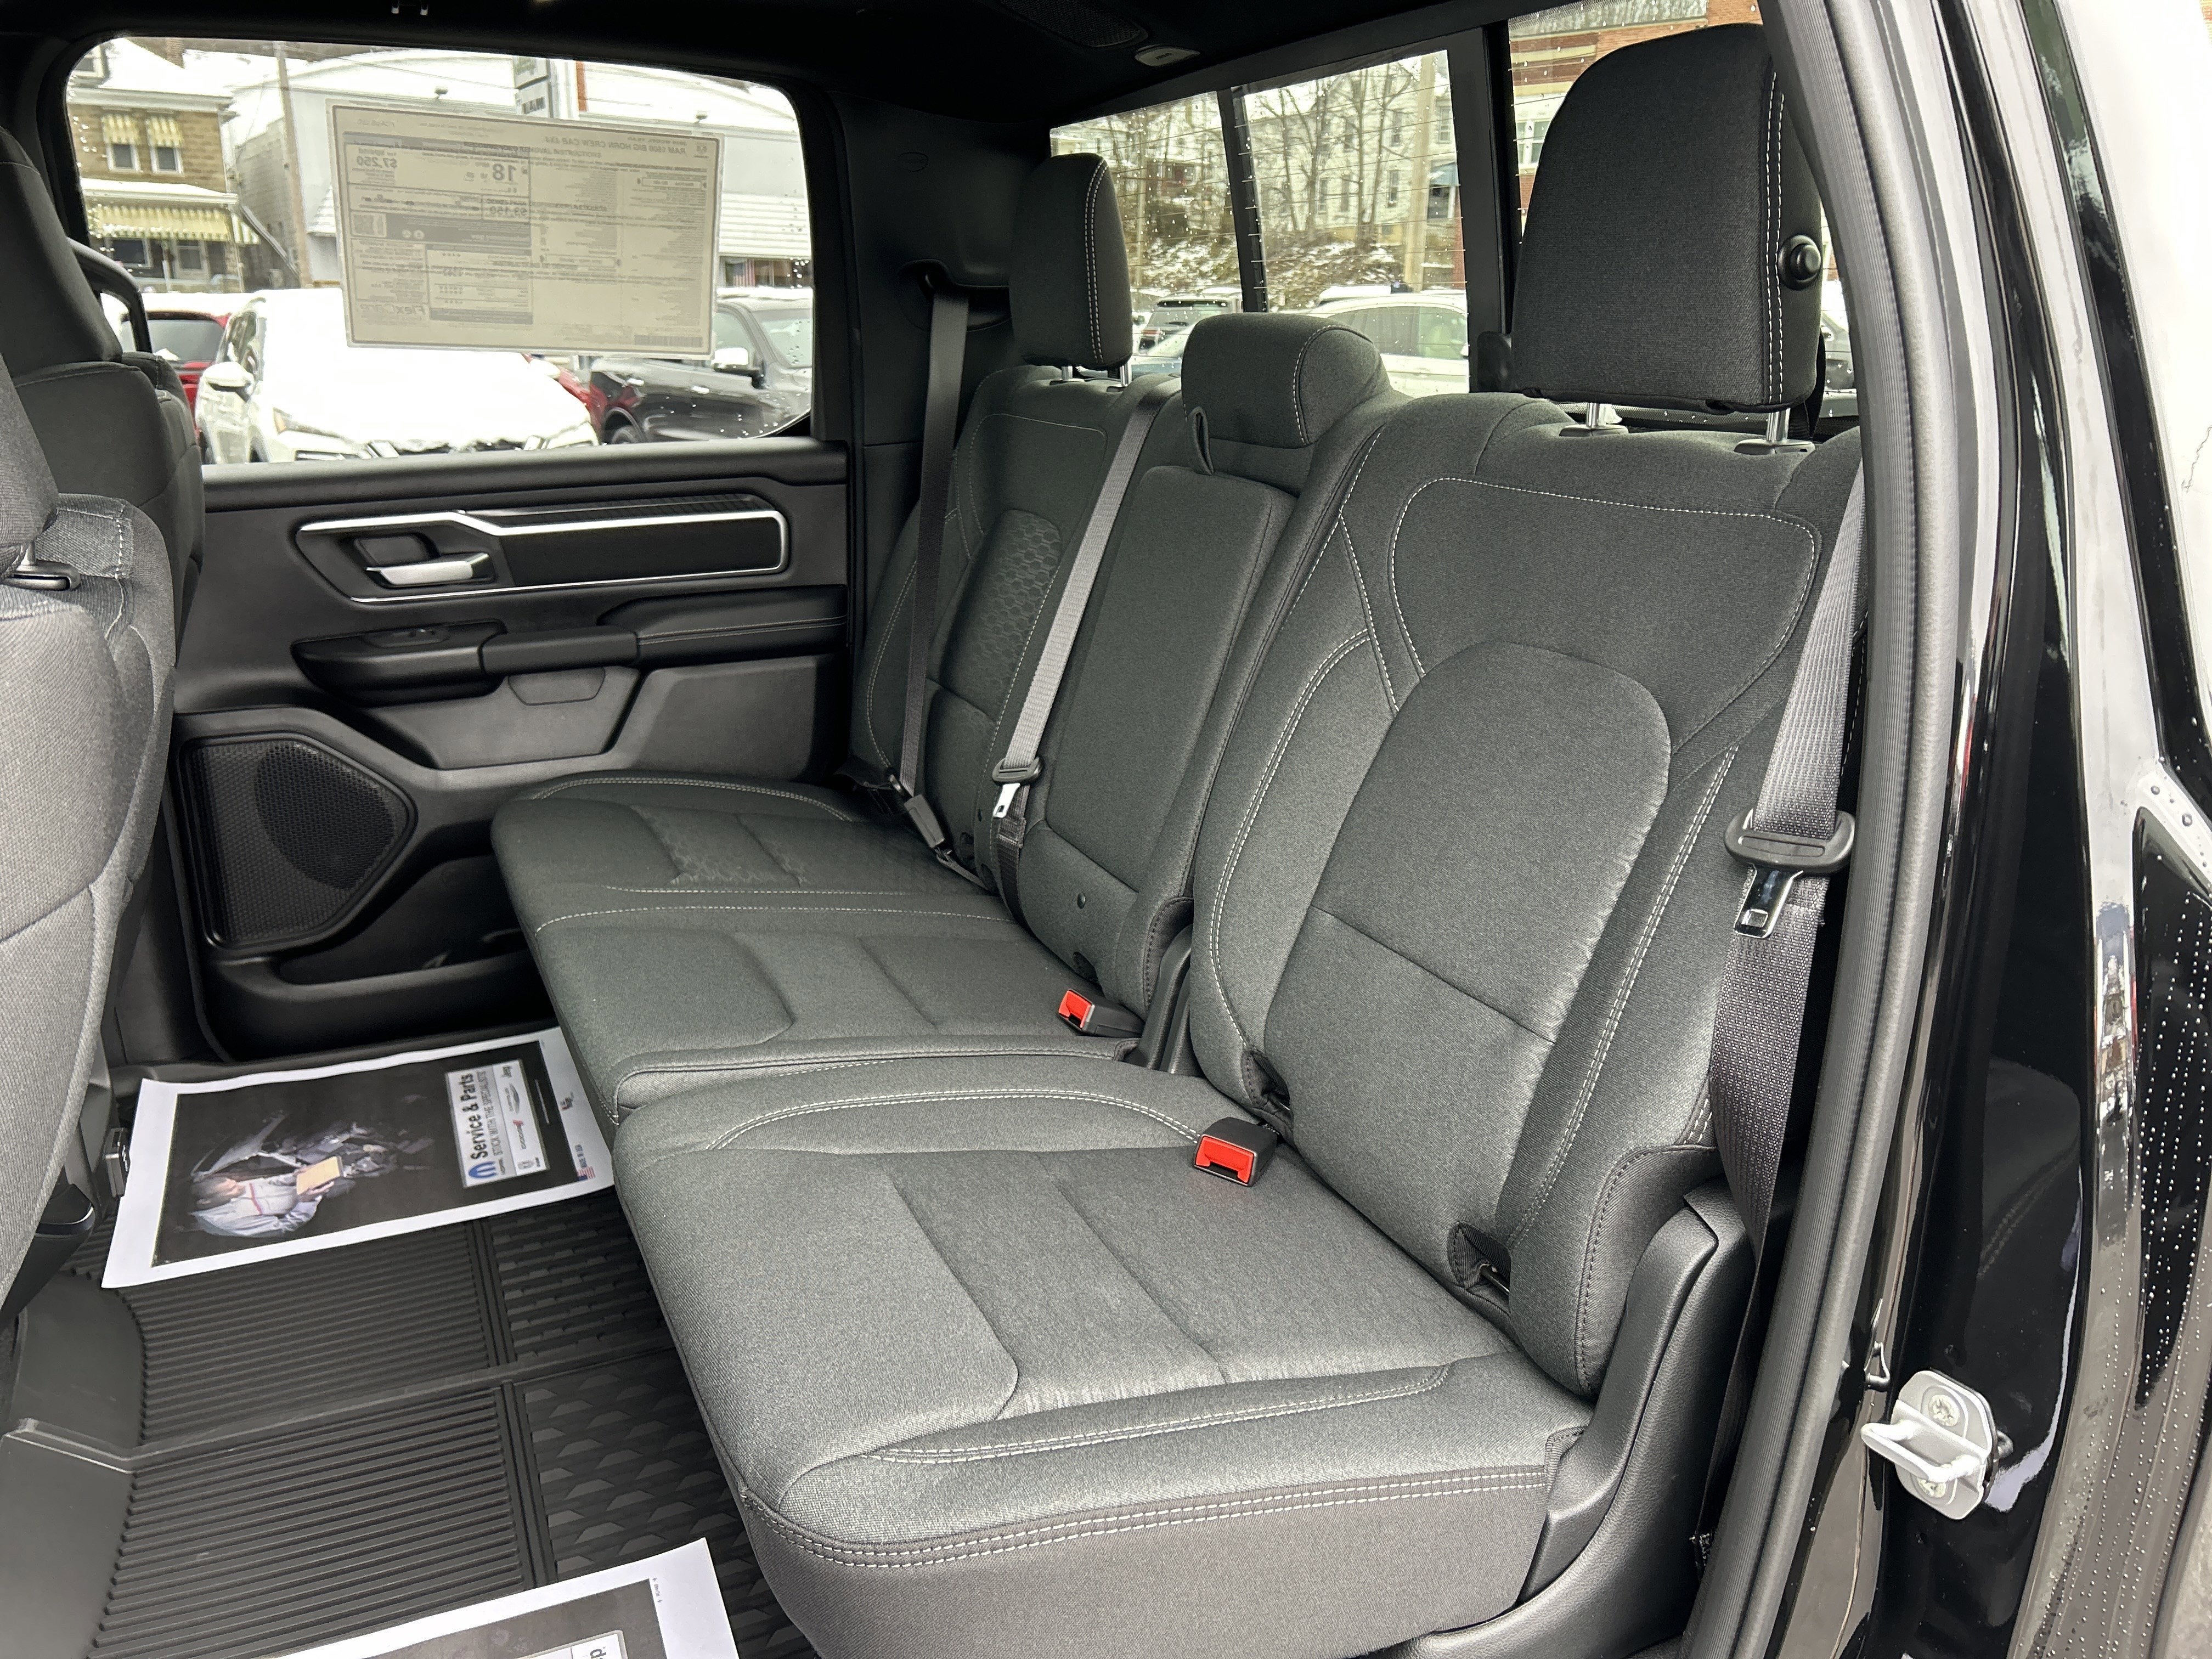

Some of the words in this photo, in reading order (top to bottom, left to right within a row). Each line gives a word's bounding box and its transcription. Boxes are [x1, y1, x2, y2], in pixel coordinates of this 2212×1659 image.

[502, 1066, 513, 1079] Jeep
[459, 1073, 476, 1101] Parts
[476, 1070, 493, 1105] SPECIALISTS
[461, 1103, 478, 1113] &
[482, 1106, 496, 1119] THE
[466, 1114, 489, 1159] Service
[487, 1119, 499, 1136] WITH
[489, 1137, 504, 1156] STICK
